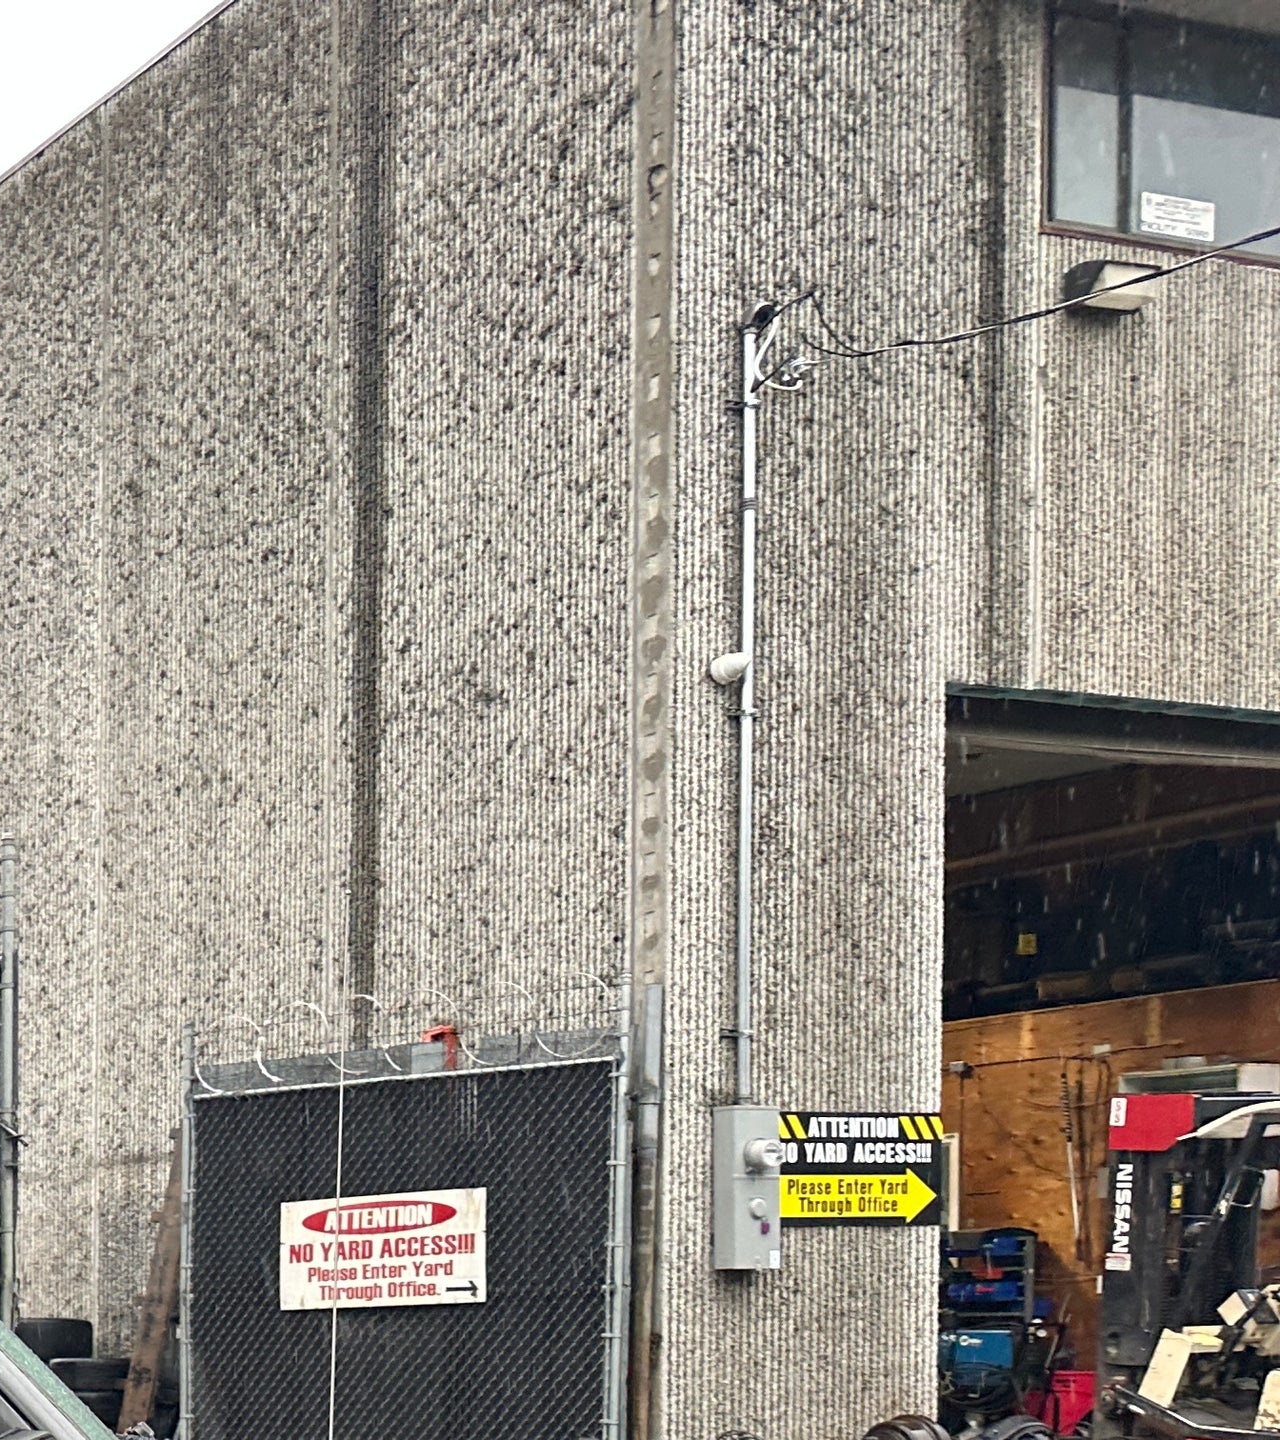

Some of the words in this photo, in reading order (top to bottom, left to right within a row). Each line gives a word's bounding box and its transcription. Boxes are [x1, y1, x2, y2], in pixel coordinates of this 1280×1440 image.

[807, 1116, 900, 1138] ATTENTION
[804, 1142, 848, 1163] YARD
[853, 1142, 932, 1163] ACCESS!!!
[787, 1179, 831, 1195] Please
[838, 1179, 873, 1195] Enter
[879, 1178, 909, 1195] Yard
[324, 1203, 433, 1231] ATTENTION
[798, 1197, 852, 1215] Through
[858, 1197, 898, 1212] Office
[1112, 1163, 1134, 1253] NISSAN
[289, 1243, 314, 1263] NO
[320, 1239, 373, 1262] YARD
[379, 1233, 475, 1259] ACCESS!!!
[308, 1266, 357, 1282] Please
[362, 1263, 407, 1279] Enter
[412, 1260, 454, 1278] Yard
[319, 1283, 383, 1301] Through
